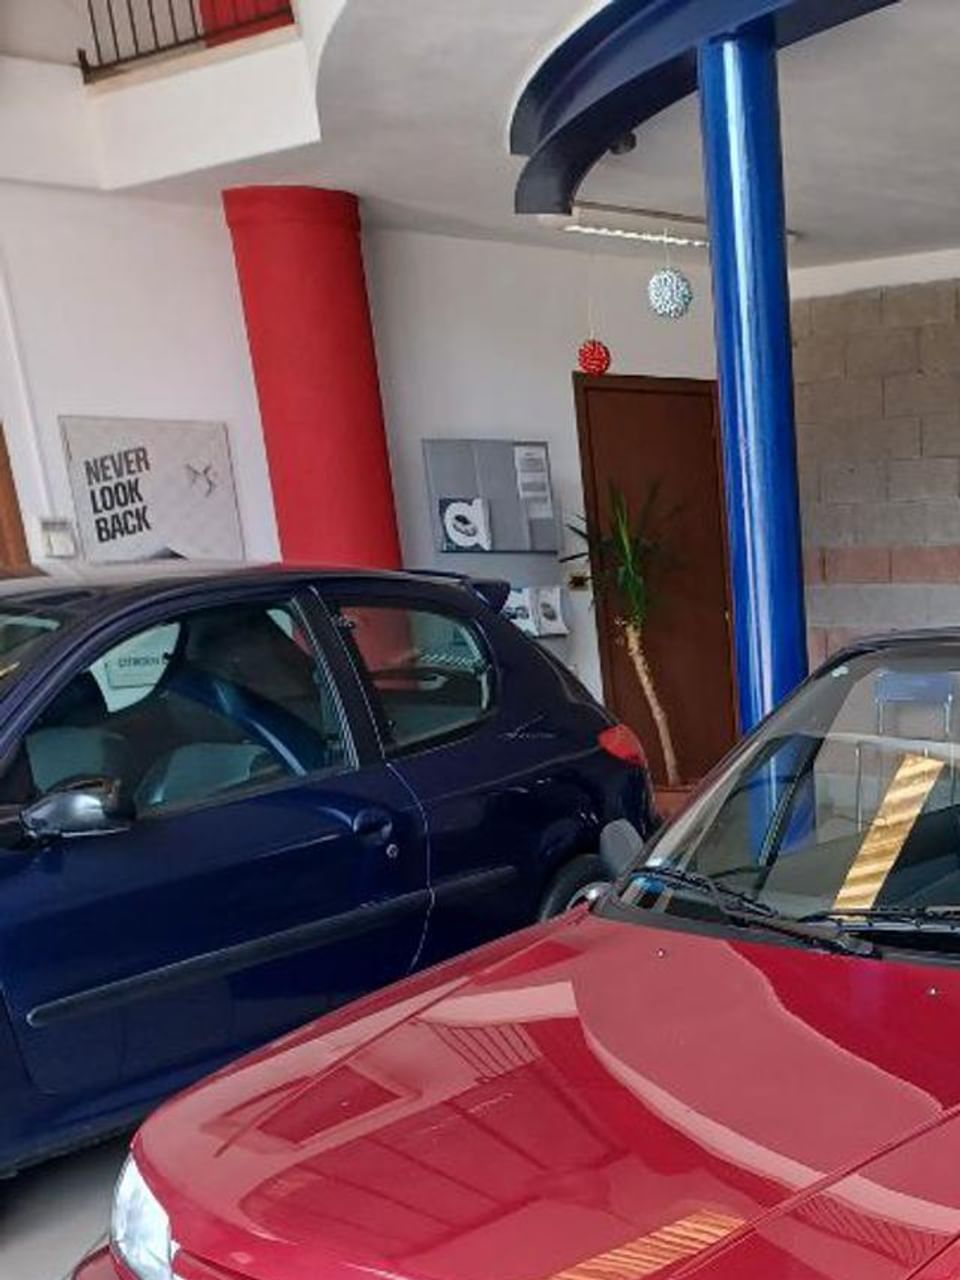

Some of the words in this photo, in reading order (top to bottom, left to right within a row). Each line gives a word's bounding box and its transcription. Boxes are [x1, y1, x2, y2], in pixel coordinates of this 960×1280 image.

[84, 447, 150, 486] NEVER
[90, 478, 144, 514] LOOK
[94, 505, 151, 543] BACK
